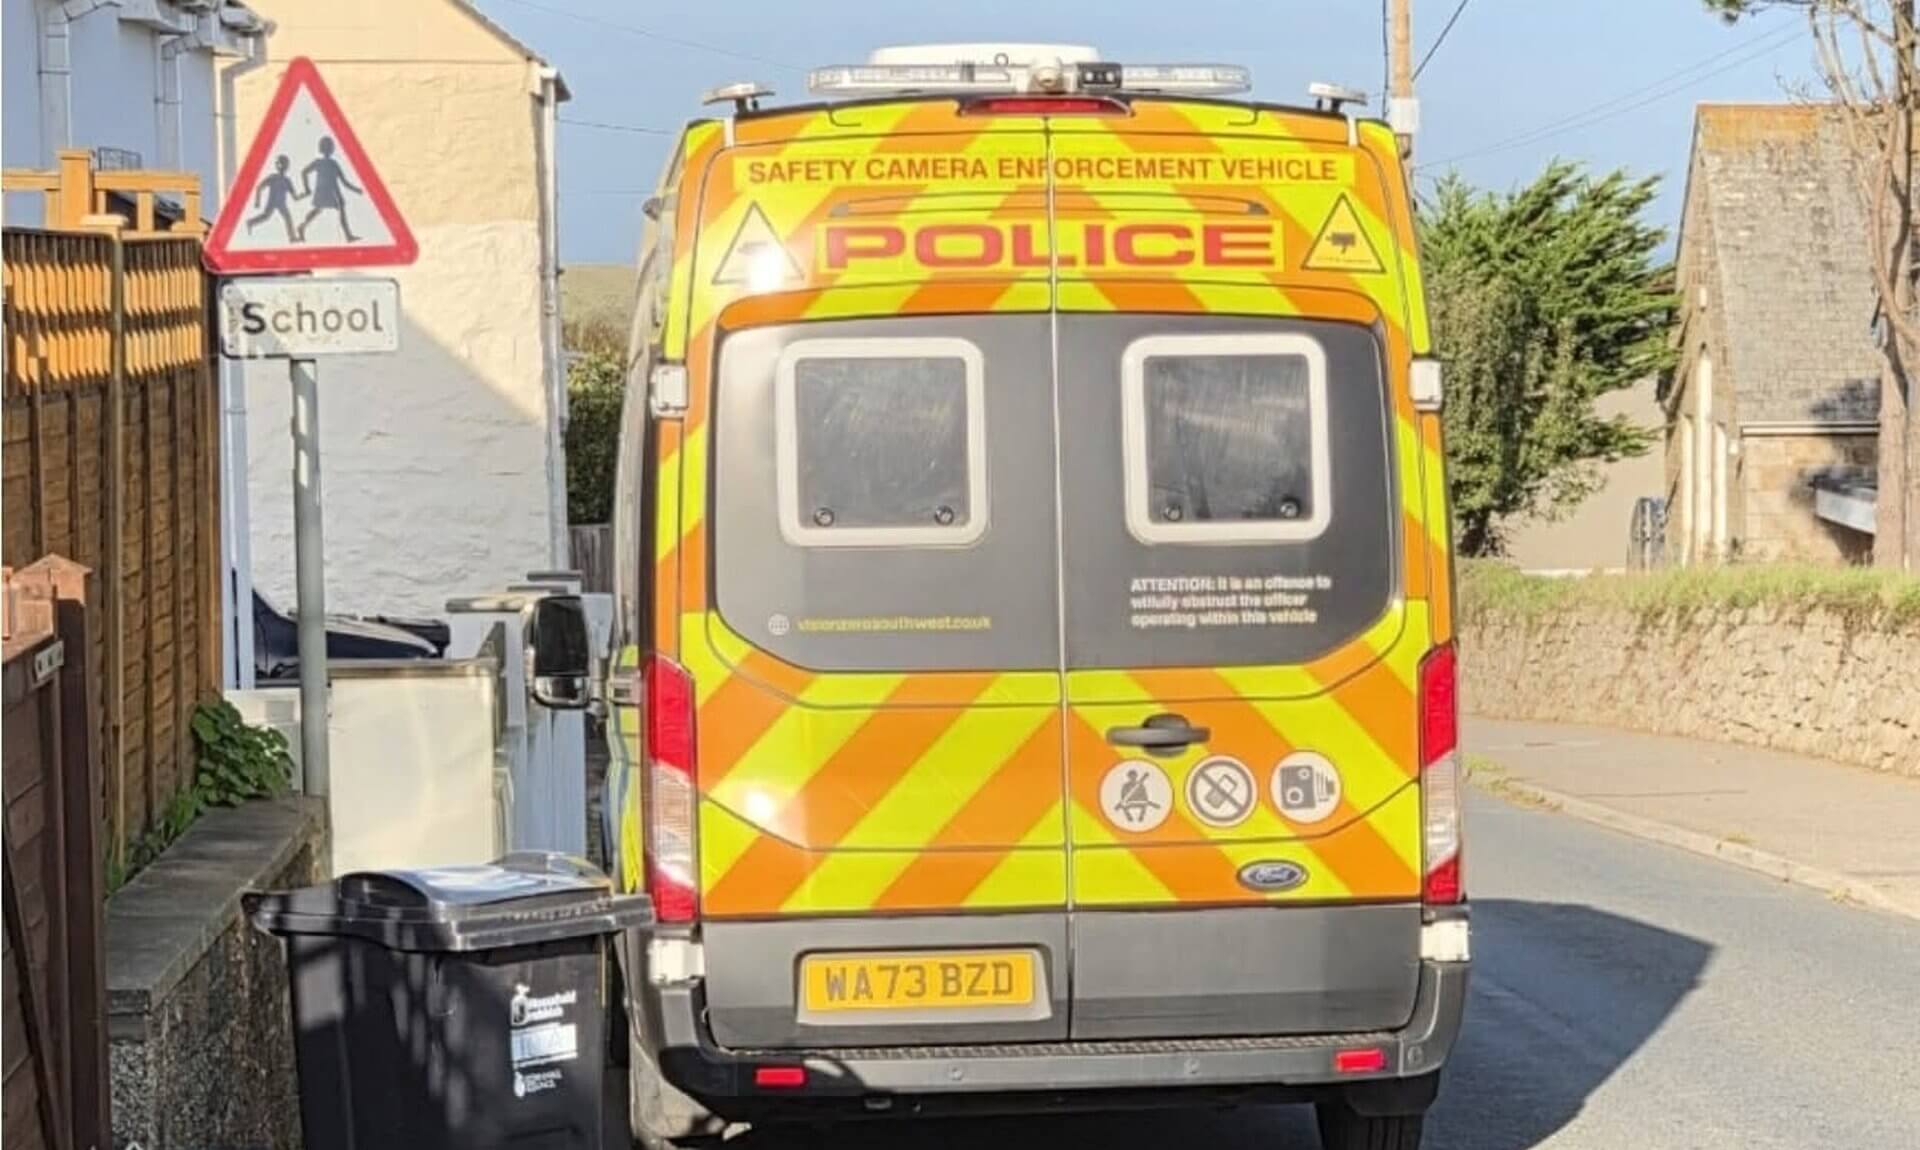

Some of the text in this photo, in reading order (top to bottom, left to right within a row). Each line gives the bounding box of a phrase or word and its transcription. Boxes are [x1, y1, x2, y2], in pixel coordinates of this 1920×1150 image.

[749, 157, 1337, 183] SAFETY CAMERA ENFORCEMENT VEHICLE
[826, 223, 1275, 268] POLICE
[242, 301, 383, 334] School
[826, 961, 1013, 1001] WA73 BZD
